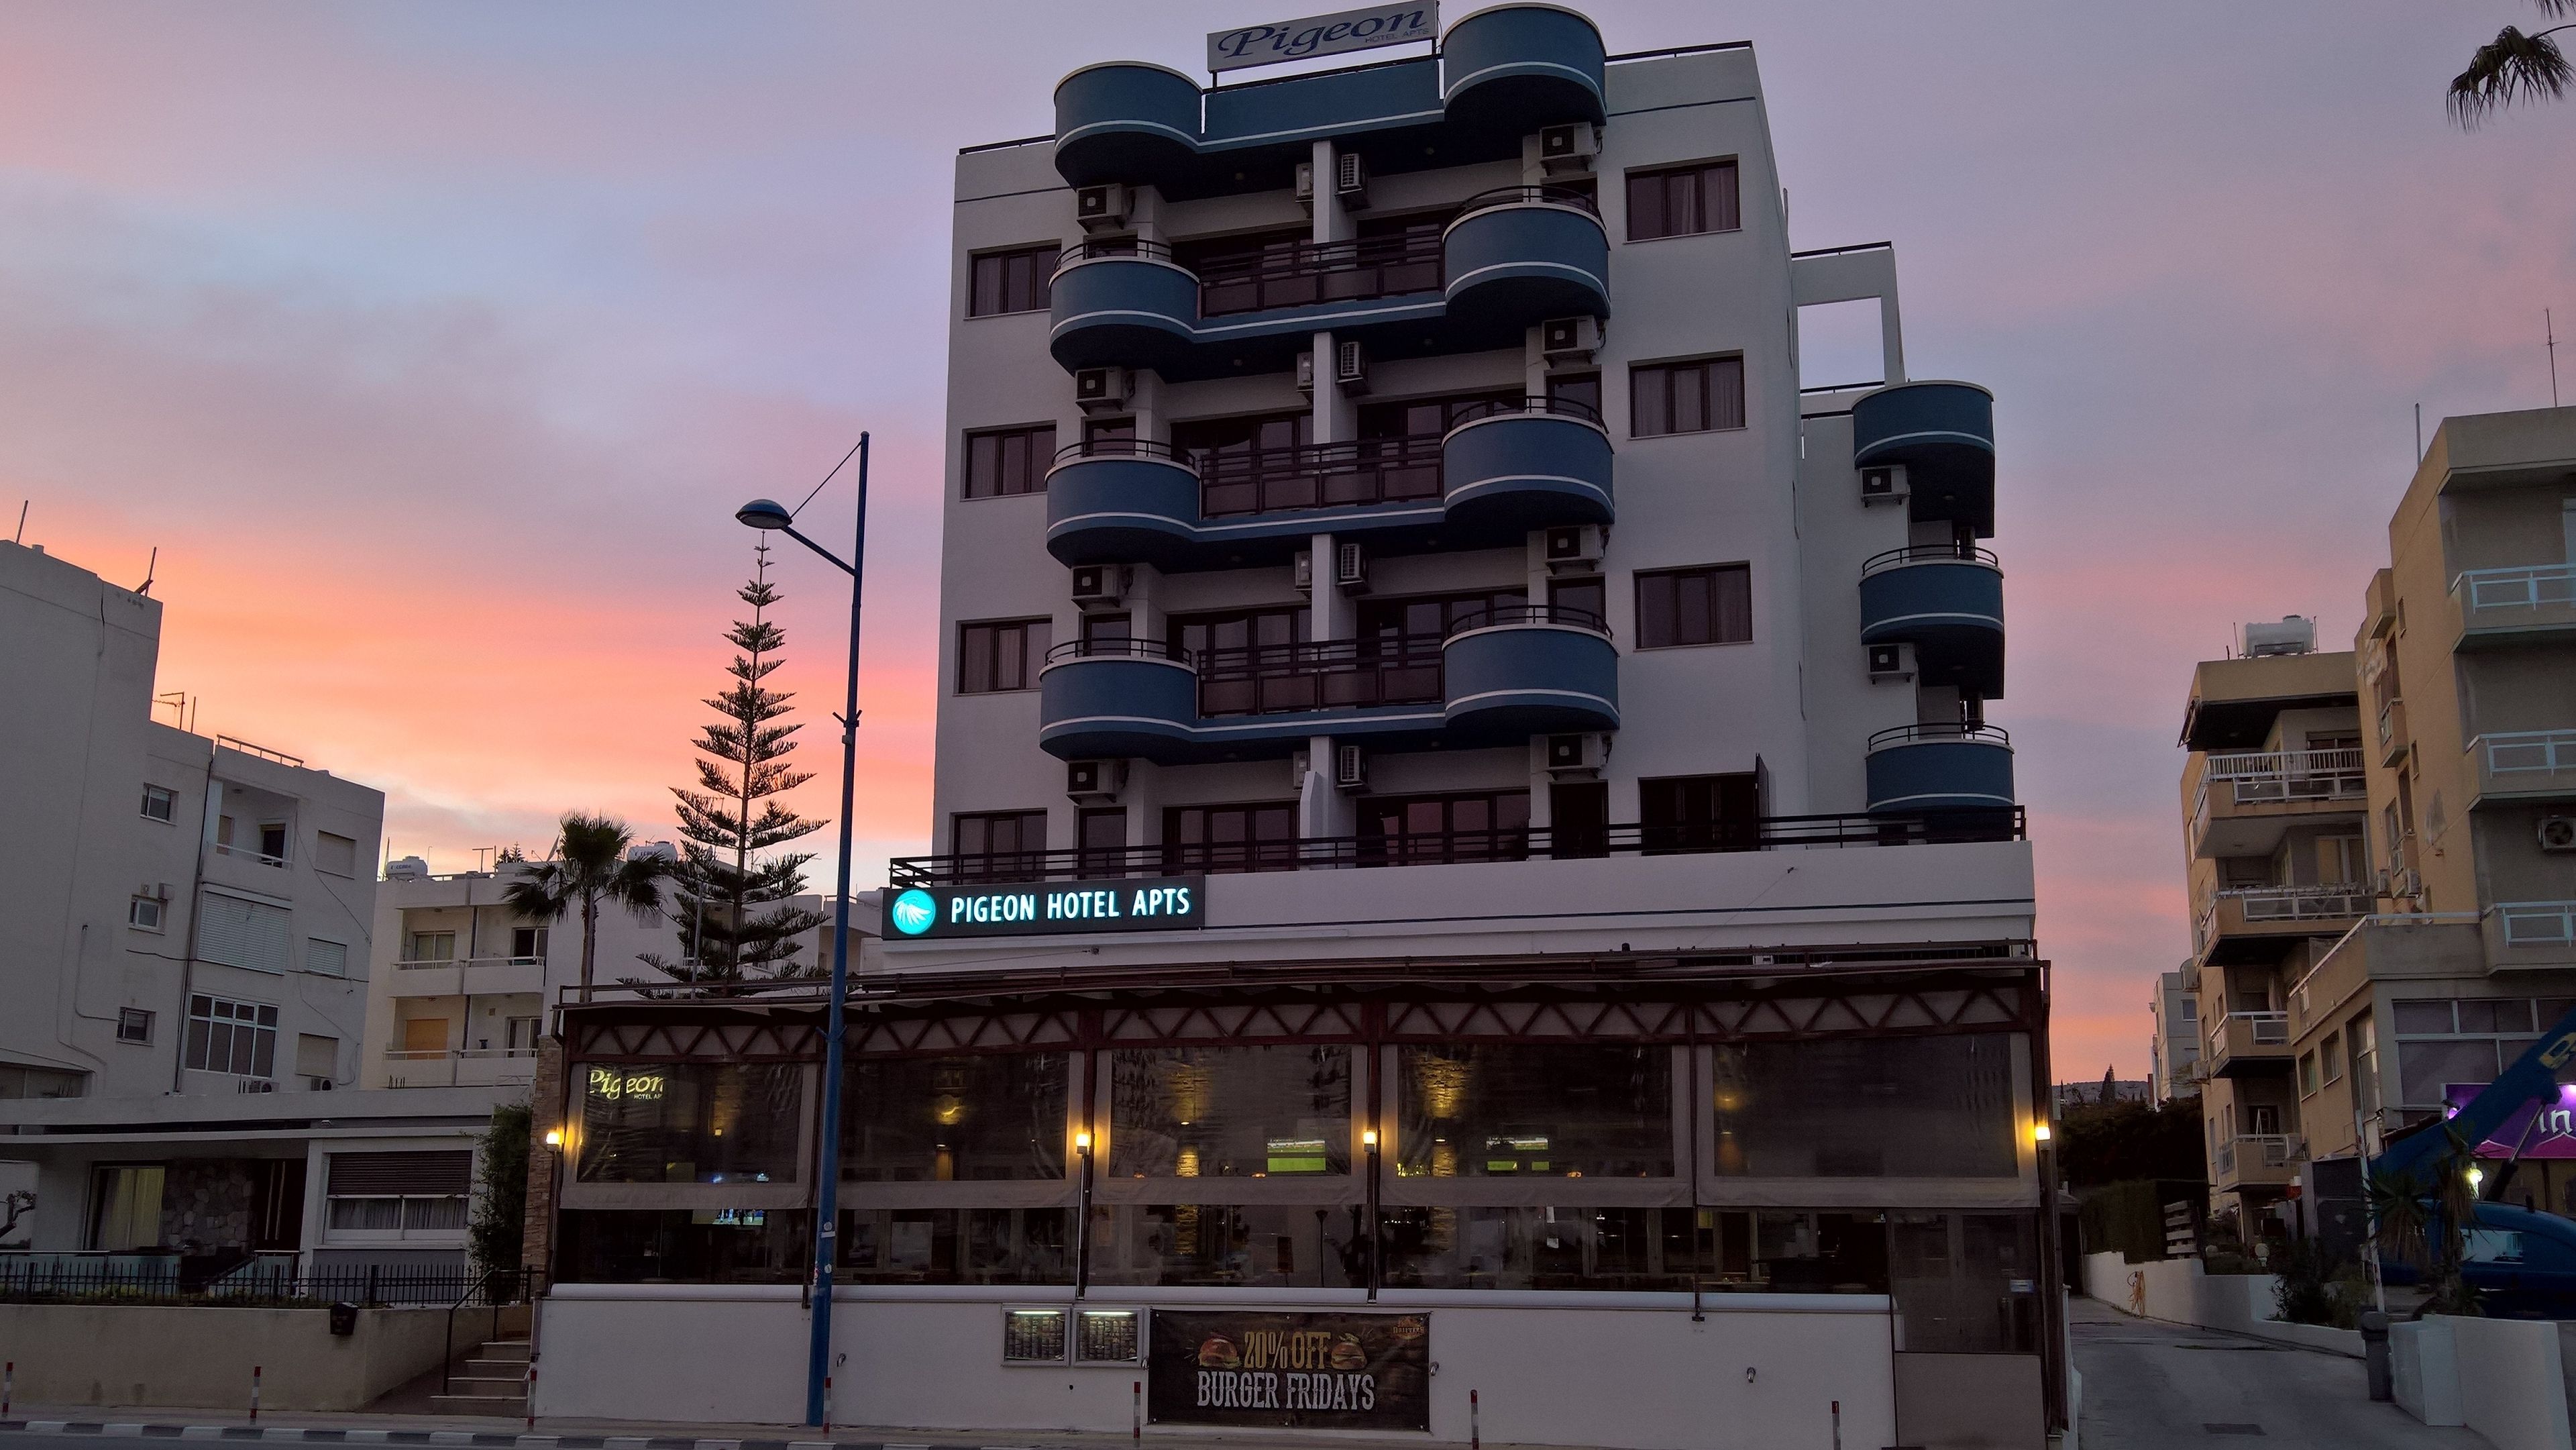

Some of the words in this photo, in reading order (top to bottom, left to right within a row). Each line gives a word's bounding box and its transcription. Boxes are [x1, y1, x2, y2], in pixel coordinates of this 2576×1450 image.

[1218, 10, 1427, 58] Pigeon
[1365, 34, 1397, 44] HOTEL
[1402, 28, 1429, 38] APTS
[951, 895, 1034, 923] PIGEON
[1047, 890, 1120, 920] HOTEL
[1132, 887, 1191, 917] APTS
[590, 1070, 663, 1100] Pigeon
[1244, 1331, 1288, 1369] 20%
[1291, 1331, 1331, 1369] OFF
[1197, 1371, 1279, 1408] BURGER
[1286, 1373, 1375, 1410] FRIDAYS
